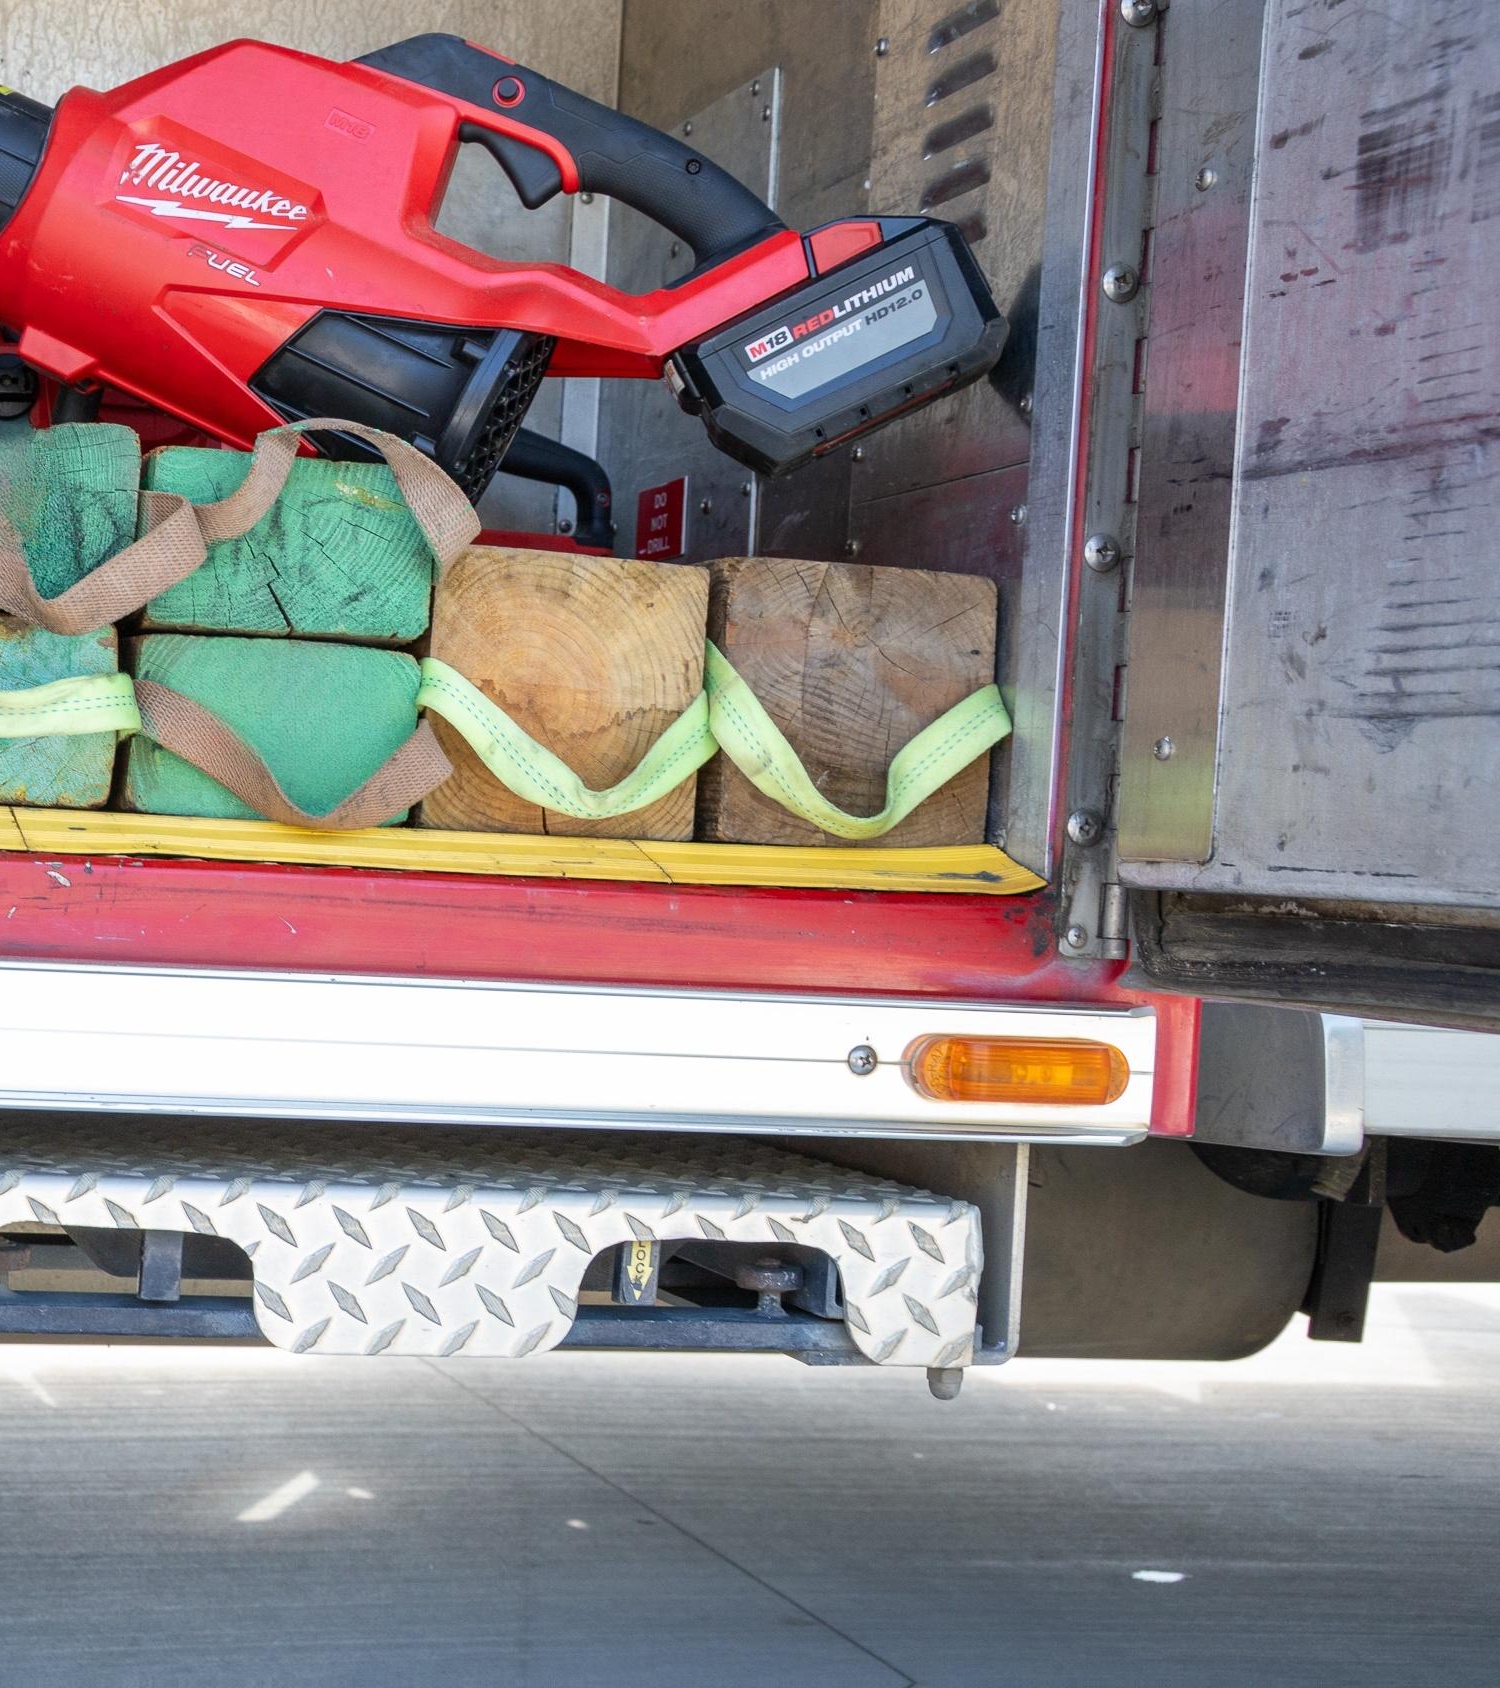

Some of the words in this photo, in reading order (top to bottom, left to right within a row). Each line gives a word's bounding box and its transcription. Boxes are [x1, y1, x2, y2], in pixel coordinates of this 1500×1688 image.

[119, 143, 308, 220] Milwaukee
[187, 244, 261, 287] FUEL
[749, 330, 789, 360] M18
[792, 265, 915, 340] REDLITHIUM
[760, 354, 800, 381] HIGH
[802, 318, 863, 358] OUTPUT
[865, 288, 923, 327] HD12.0
[650, 513, 669, 532] NOT
[654, 491, 668, 510] DO
